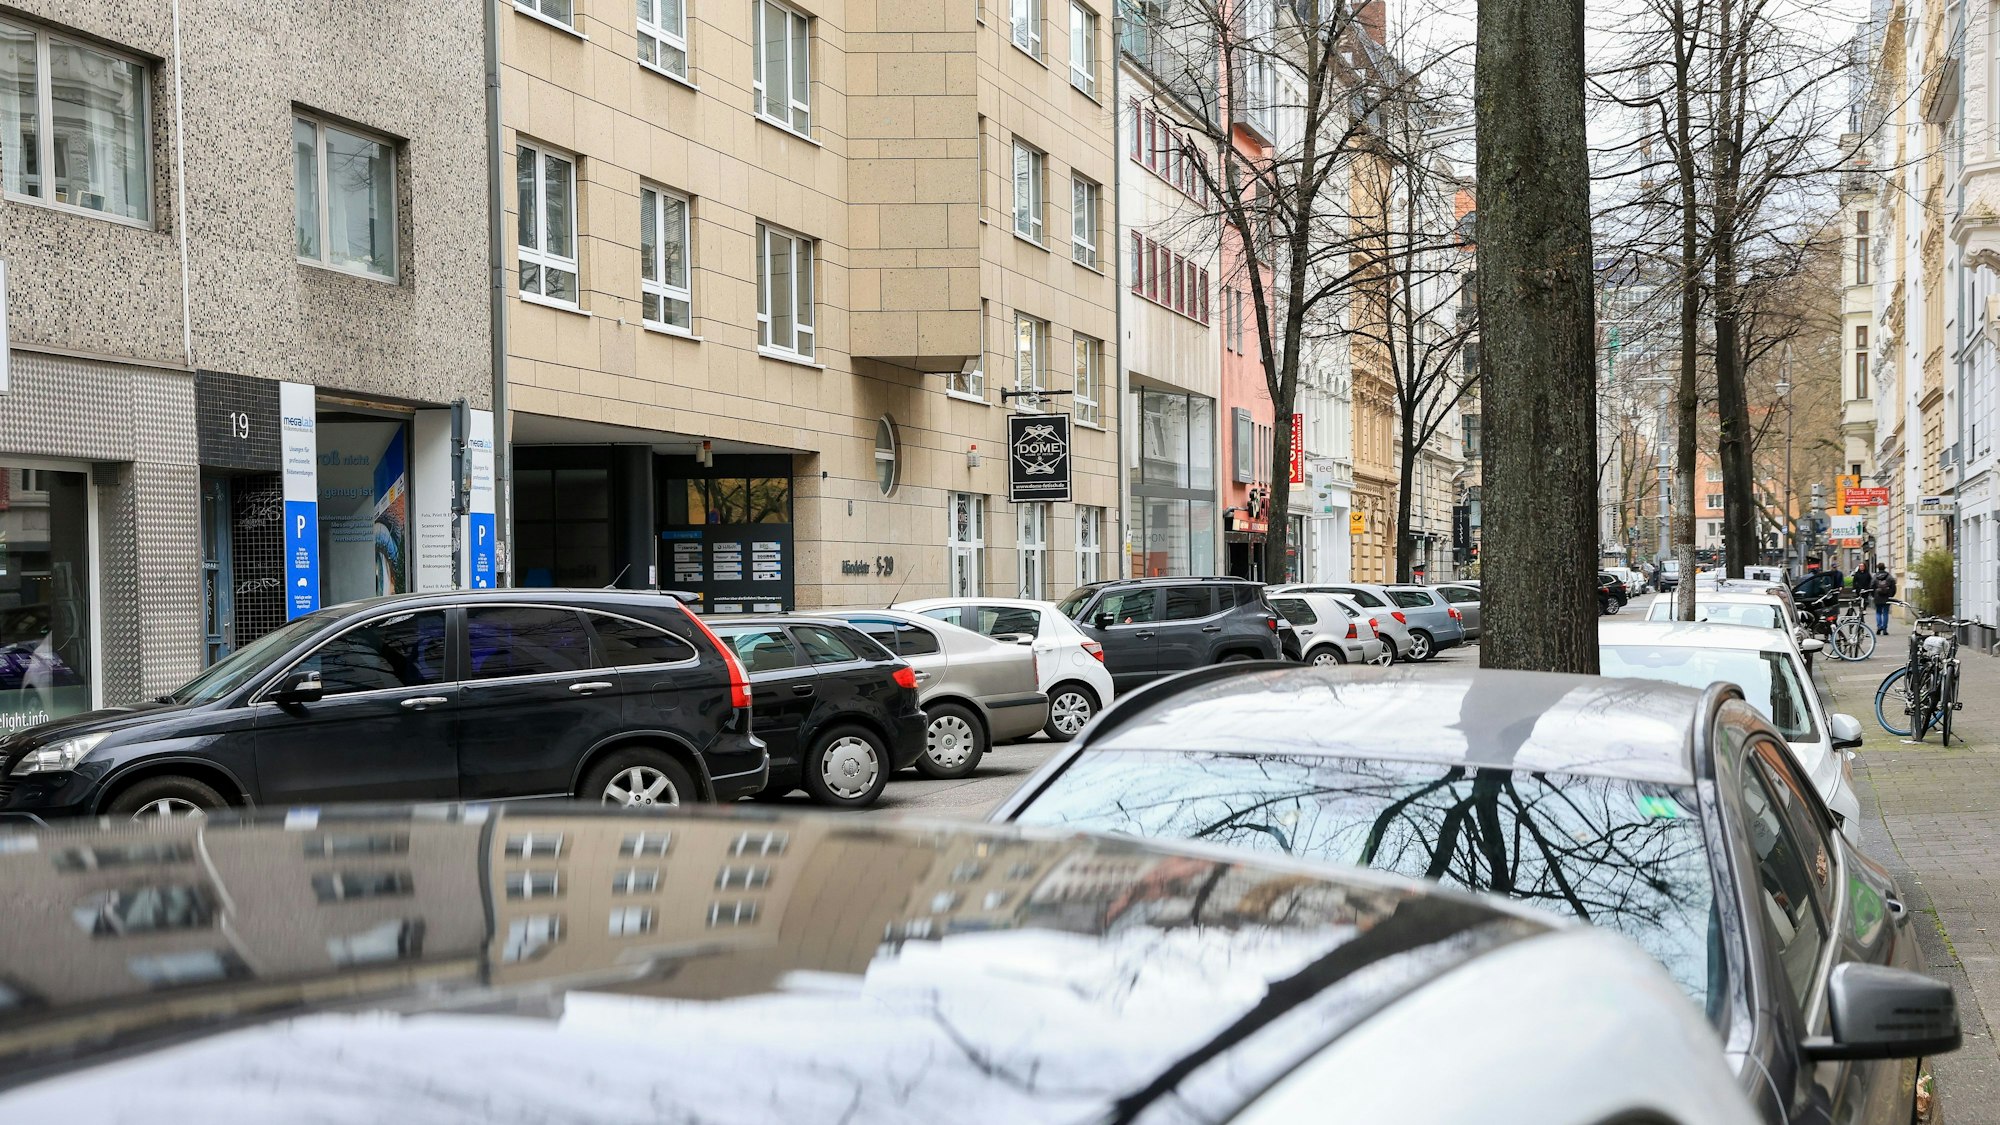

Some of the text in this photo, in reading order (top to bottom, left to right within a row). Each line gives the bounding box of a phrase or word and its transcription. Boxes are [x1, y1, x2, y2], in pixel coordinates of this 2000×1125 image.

[230, 412, 249, 439] 19
[1019, 443, 1061, 454] DOME
[344, 454, 370, 466] nicht
[1314, 463, 1332, 473] Tee
[324, 487, 356, 499] genug
[359, 486, 374, 496] ist
[1846, 488, 1865, 496] Pizza
[297, 514, 306, 539] P
[1832, 526, 1856, 534] PAUL'S
[478, 524, 486, 546] P
